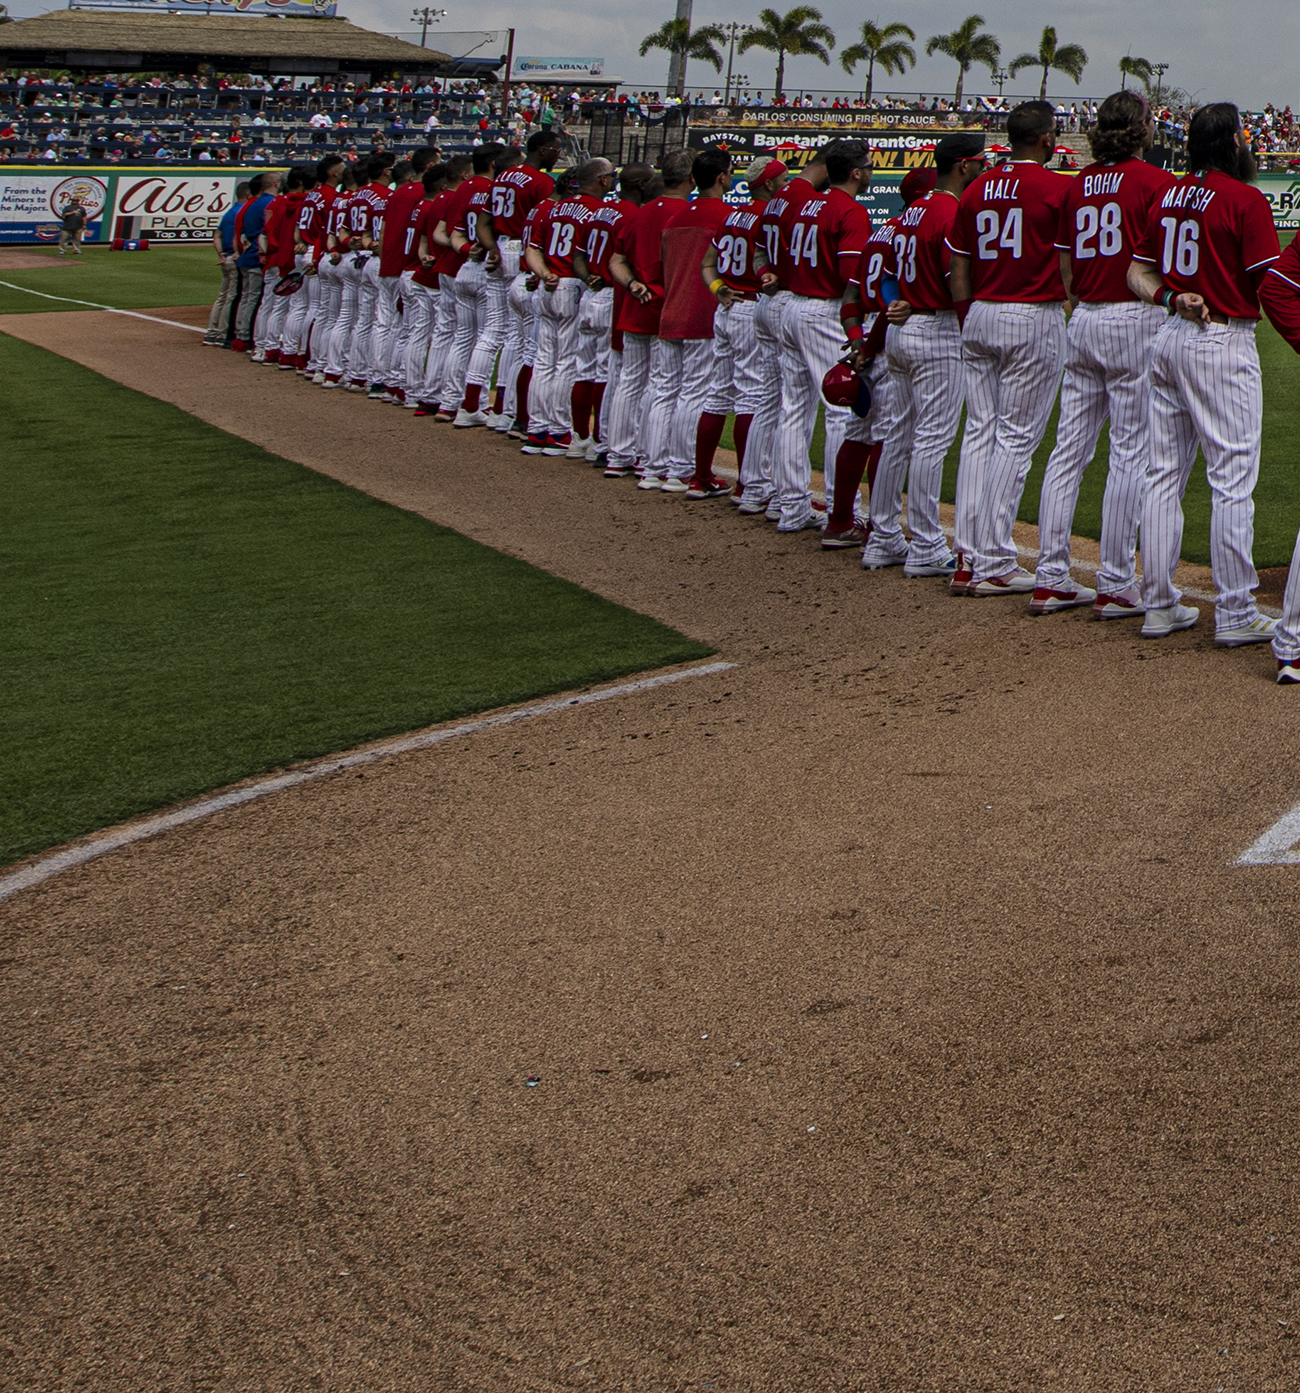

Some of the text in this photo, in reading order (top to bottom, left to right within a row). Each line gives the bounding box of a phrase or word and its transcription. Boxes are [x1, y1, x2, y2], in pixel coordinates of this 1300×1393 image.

[742, 112, 936, 125] CARLOS' CONSUMING FIRE HOT SAUCE
[702, 133, 747, 145] BAYSTAR
[4, 187, 47, 195] From the
[119, 178, 231, 214] Abe's
[984, 179, 1020, 201] HALL
[1083, 172, 1125, 198] BOHM
[15, 204, 49, 214] Majors.
[36, 196, 47, 204] to
[491, 186, 516, 218] 53
[1161, 186, 1216, 212] MARSH
[151, 217, 219, 228] PLACE
[350, 206, 367, 231] 85
[1076, 202, 1122, 259] 28
[154, 231, 175, 239] Tap
[548, 222, 575, 257] 13
[790, 222, 818, 268] 44
[976, 208, 1023, 260] 24
[1160, 216, 1199, 276] 16
[717, 234, 748, 276] 39
